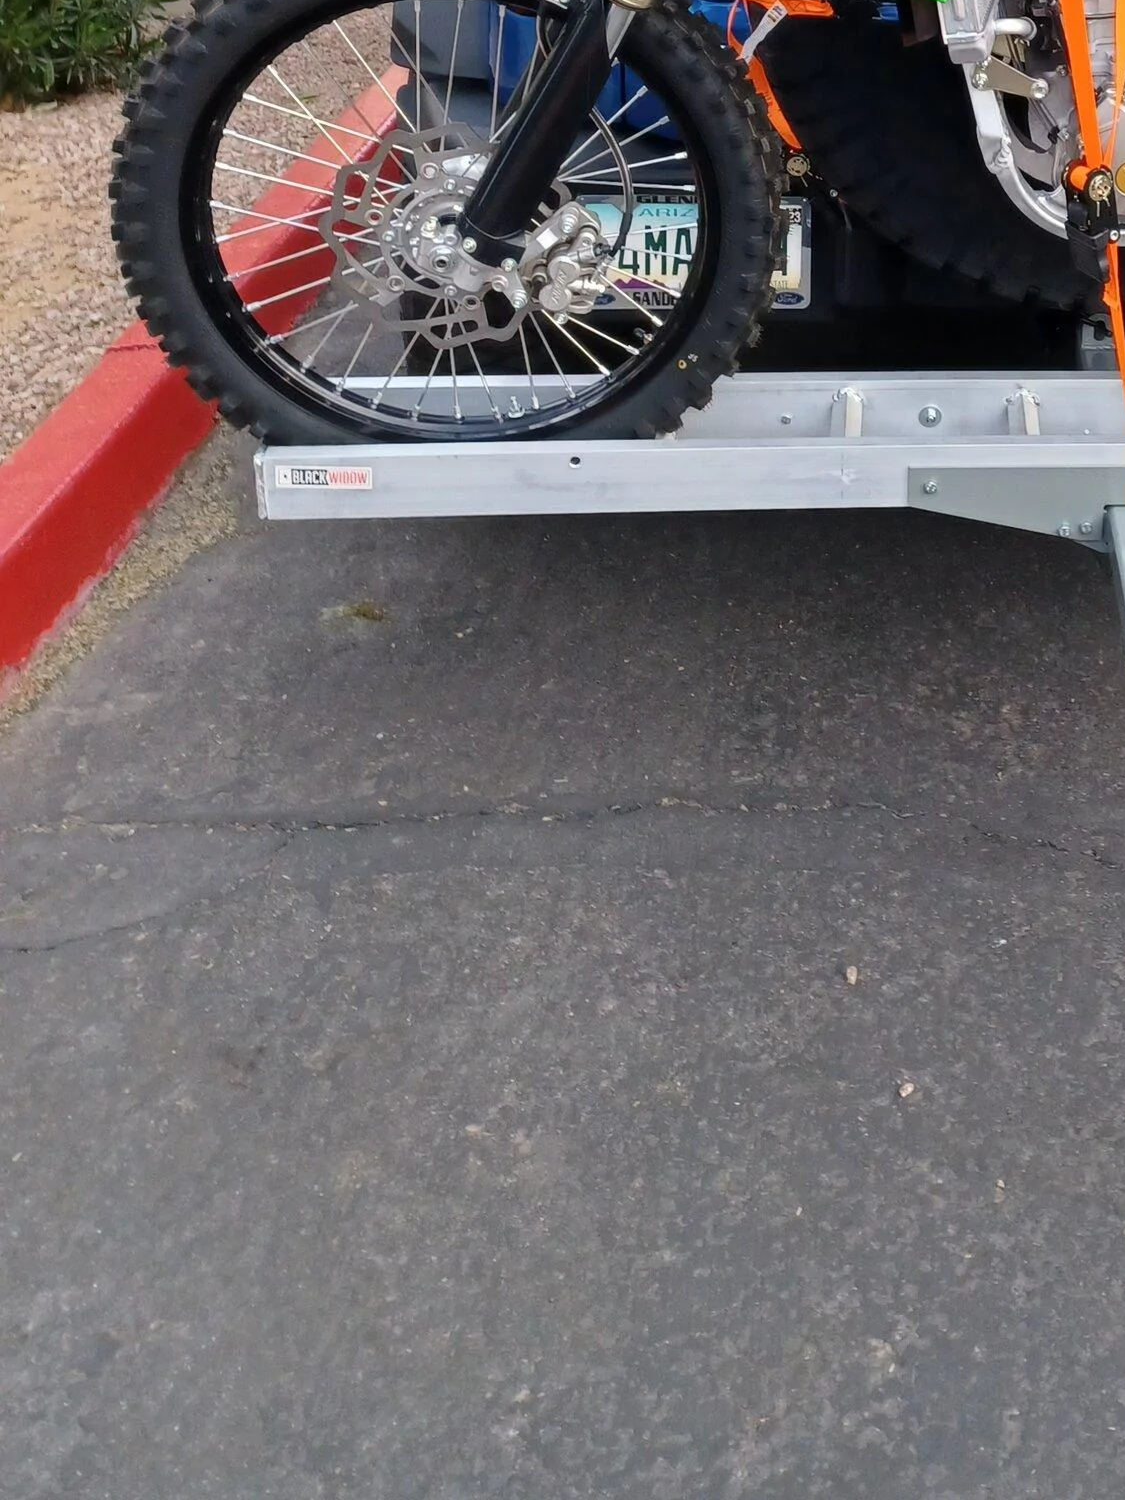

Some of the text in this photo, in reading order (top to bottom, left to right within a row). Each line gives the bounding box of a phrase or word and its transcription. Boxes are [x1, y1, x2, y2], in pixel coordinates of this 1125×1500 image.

[636, 195, 698, 204] GLEN
[638, 207, 695, 217] ARIZ
[618, 224, 693, 276] 4MA
[292, 469, 368, 485] BLACK WIDOW
